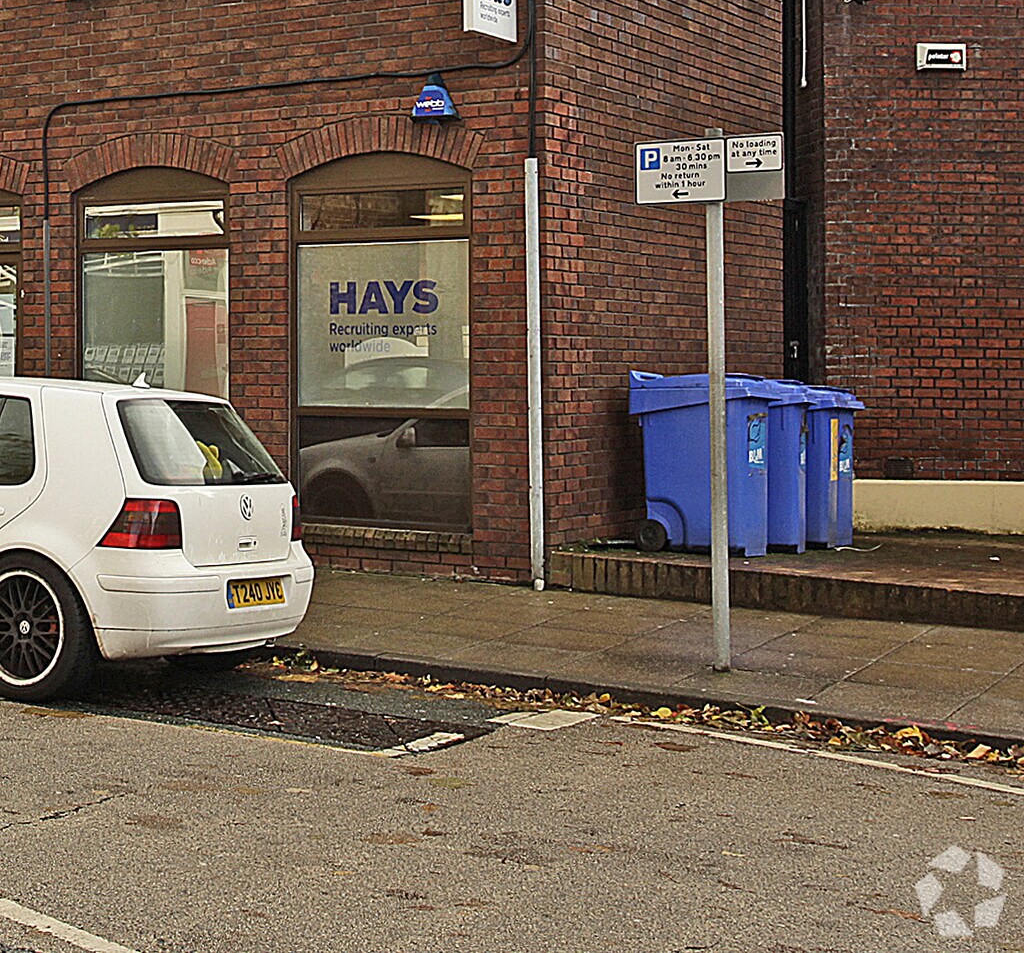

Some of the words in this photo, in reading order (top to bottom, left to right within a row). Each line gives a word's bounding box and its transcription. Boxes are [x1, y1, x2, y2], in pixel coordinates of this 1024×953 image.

[416, 99, 445, 108] webb
[746, 139, 777, 148] loading
[644, 150, 658, 169] P
[742, 150, 756, 158] any
[759, 148, 777, 156] time
[655, 181, 679, 189] within
[329, 280, 438, 315] HAYS
[329, 322, 388, 337] Recruiting
[392, 323, 437, 337] experts
[329, 339, 391, 352] worldwide
[232, 582, 263, 604] T240
[265, 581, 284, 601] JYE
